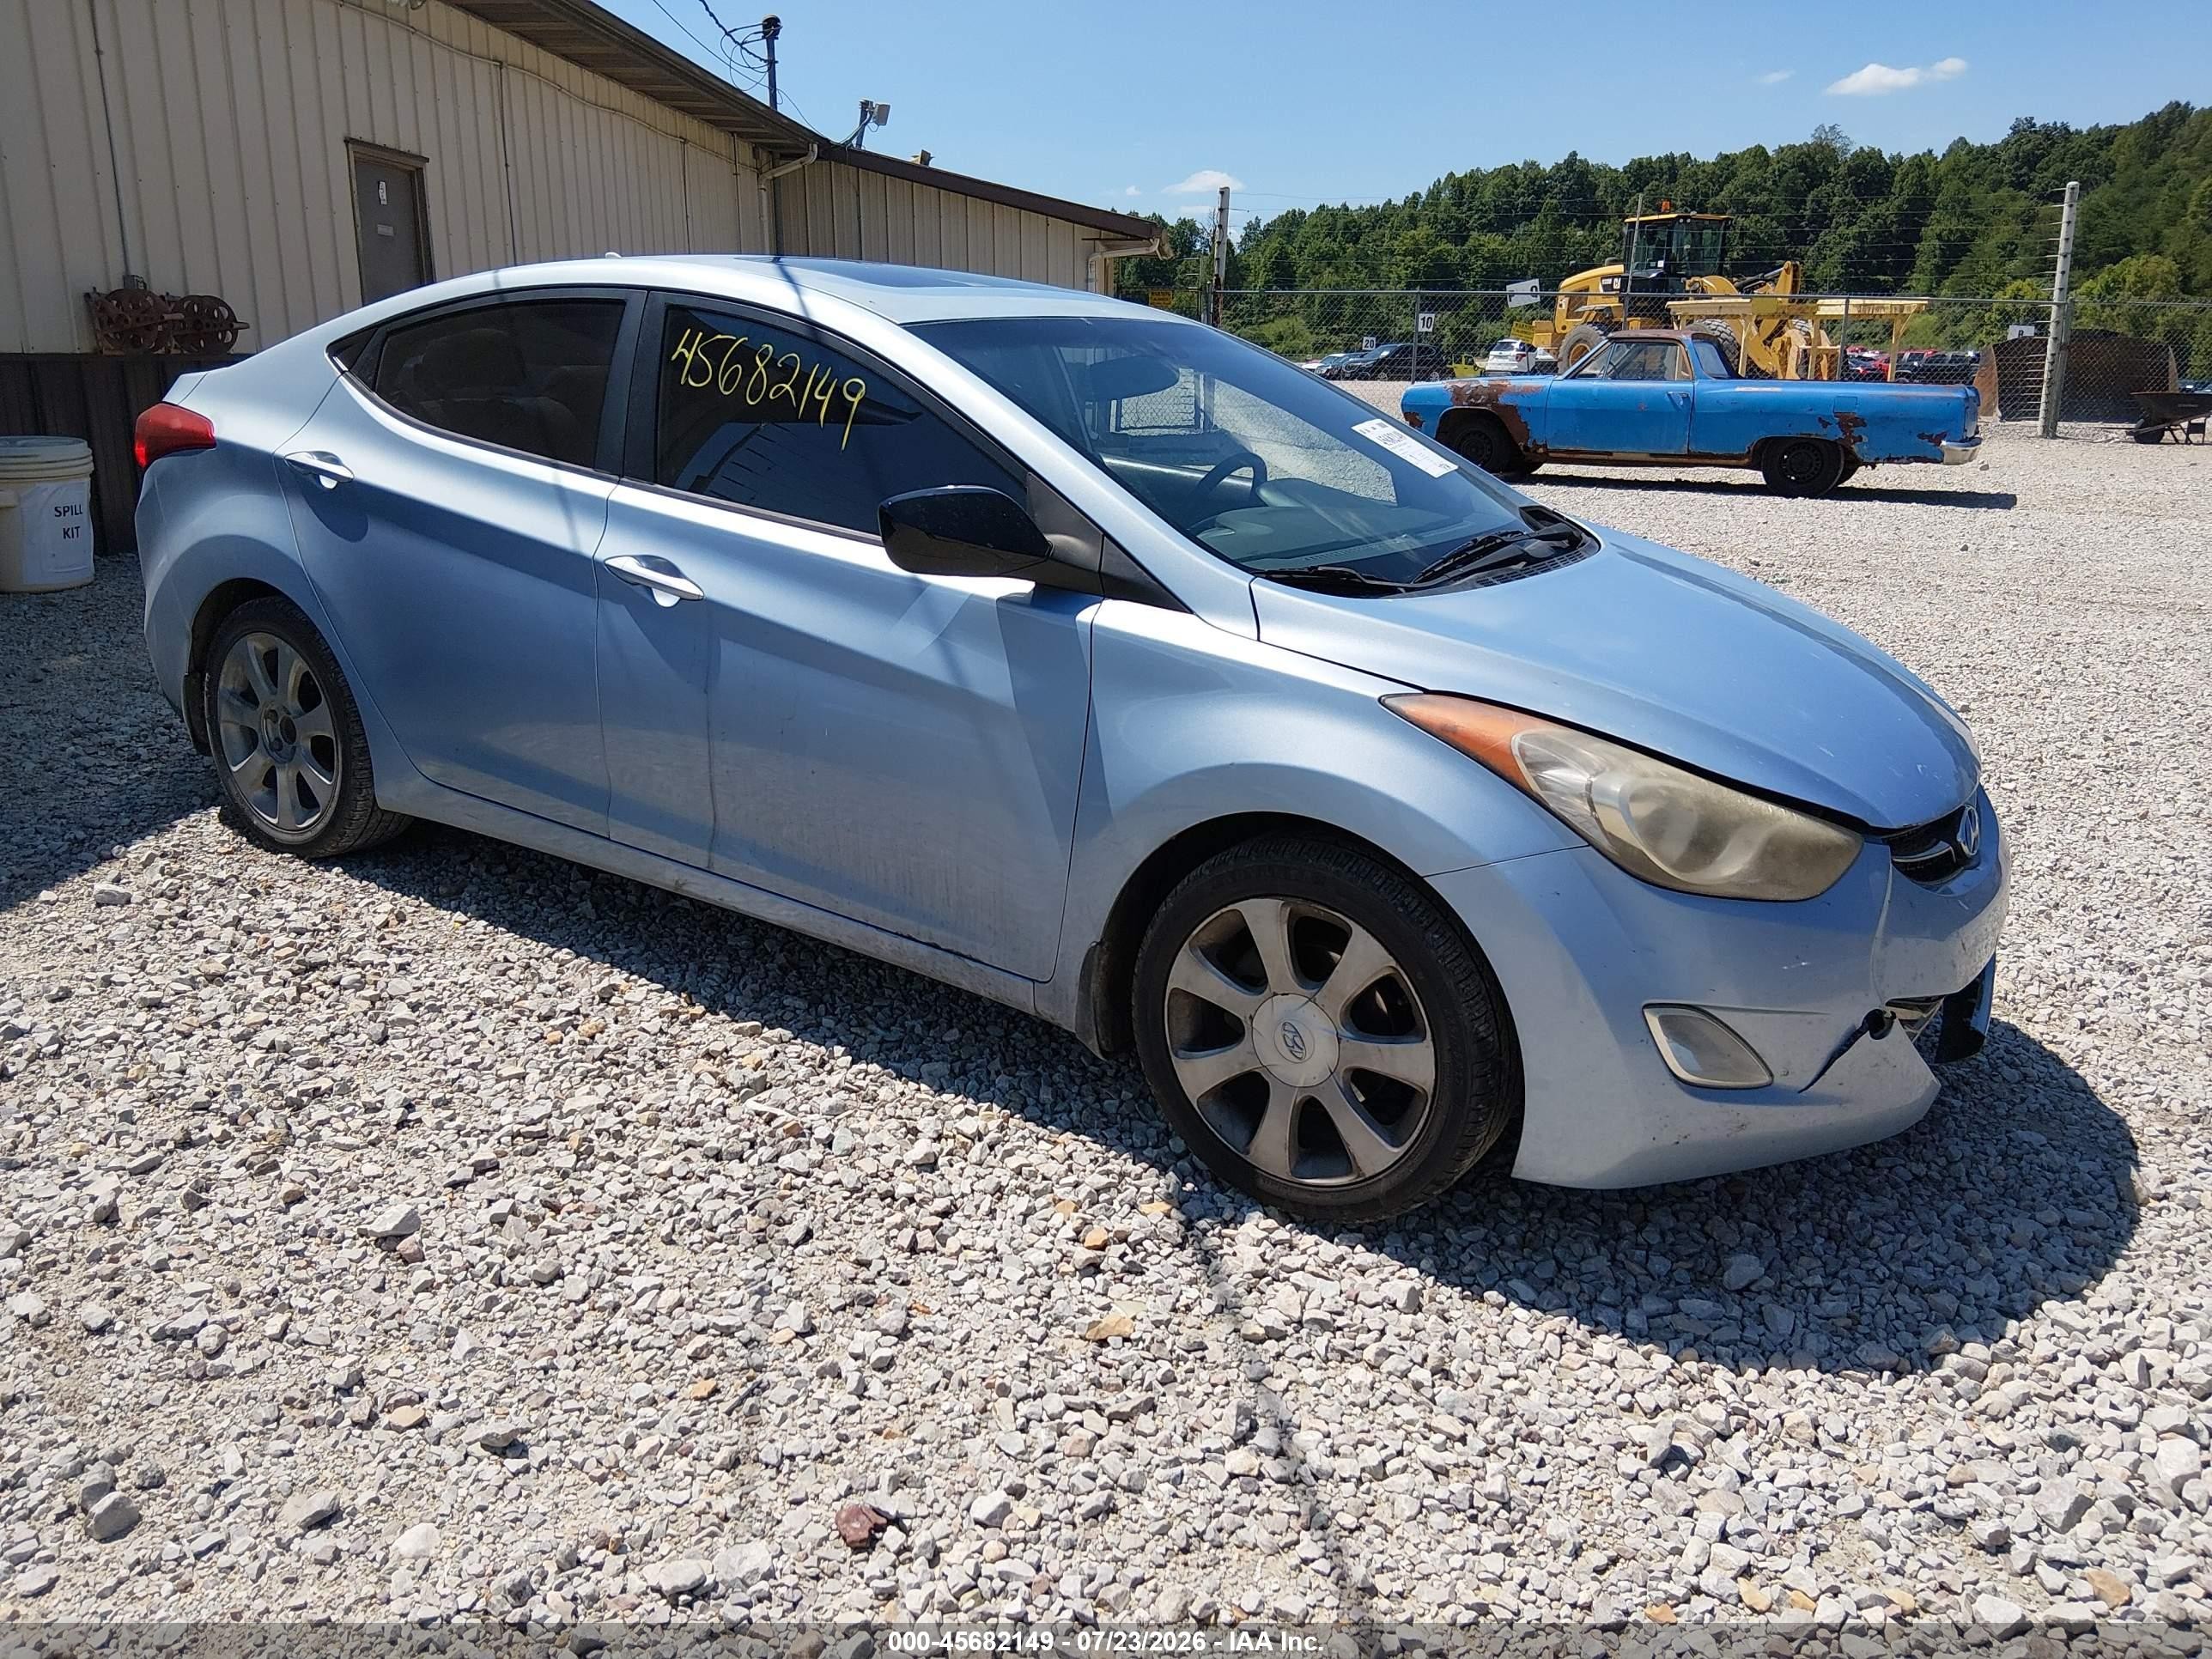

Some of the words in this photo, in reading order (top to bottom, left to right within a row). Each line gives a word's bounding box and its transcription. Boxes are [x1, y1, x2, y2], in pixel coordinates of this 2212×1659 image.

[1420, 316, 1433, 330] 10
[1364, 339, 1375, 349] 20
[672, 329, 866, 451] 45682149
[54, 503, 82, 518] SPILL
[63, 526, 81, 539] KIT
